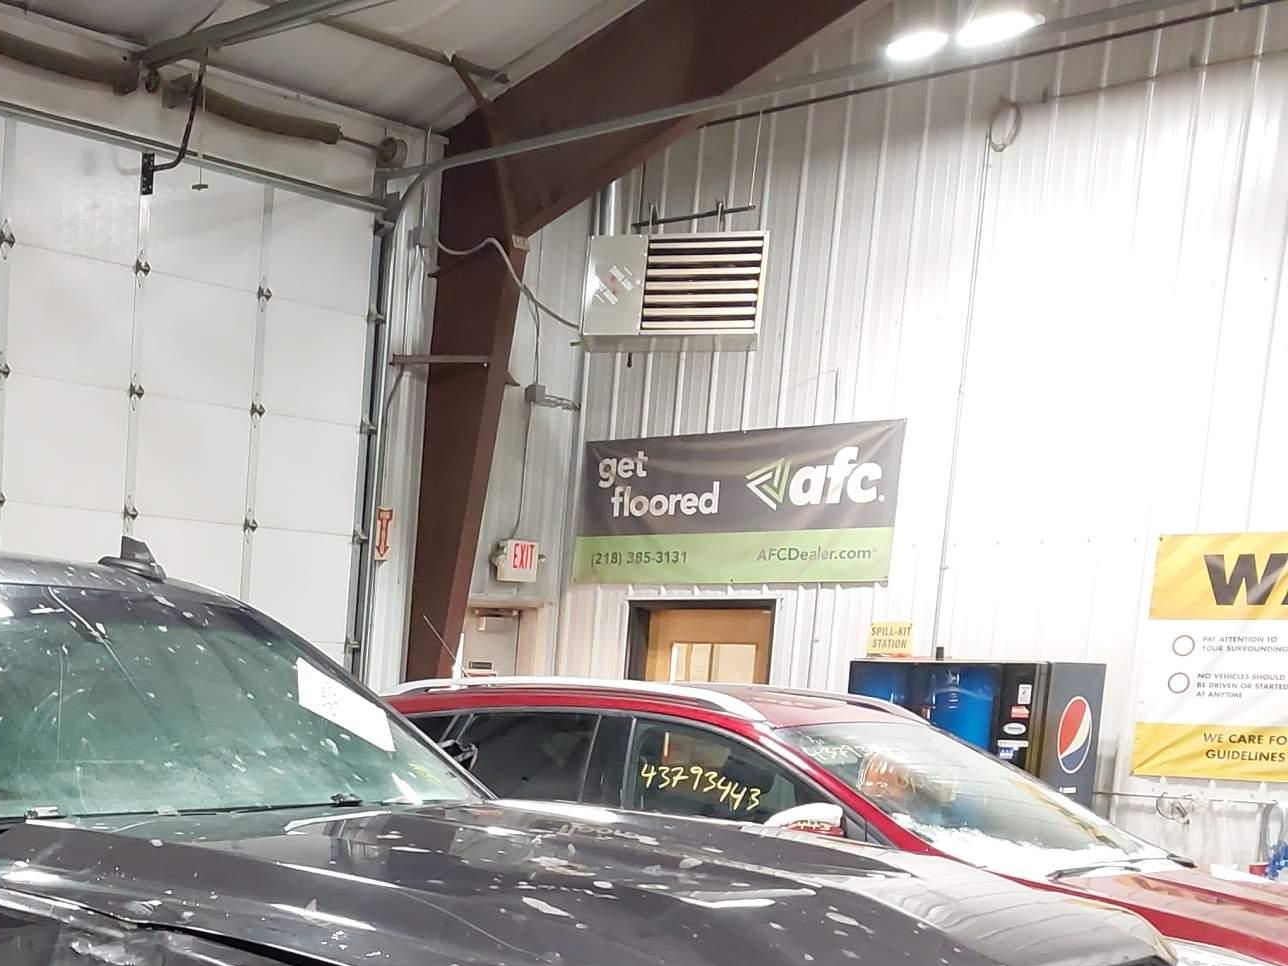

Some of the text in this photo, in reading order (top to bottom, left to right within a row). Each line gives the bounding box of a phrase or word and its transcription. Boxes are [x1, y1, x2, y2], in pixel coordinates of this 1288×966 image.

[598, 450, 649, 488] get
[610, 480, 720, 518] floored
[512, 542, 536, 570] EXIT
[590, 550, 688, 568] (218) 385-3131
[1202, 552, 1288, 606] W
[871, 626, 911, 637] SPILL-KIT
[872, 639, 907, 649] STATION
[1203, 732, 1224, 744] WE
[1228, 733, 1264, 745] CARE
[1205, 748, 1287, 763] GUIDELINES
[641, 763, 762, 812] 43793443
